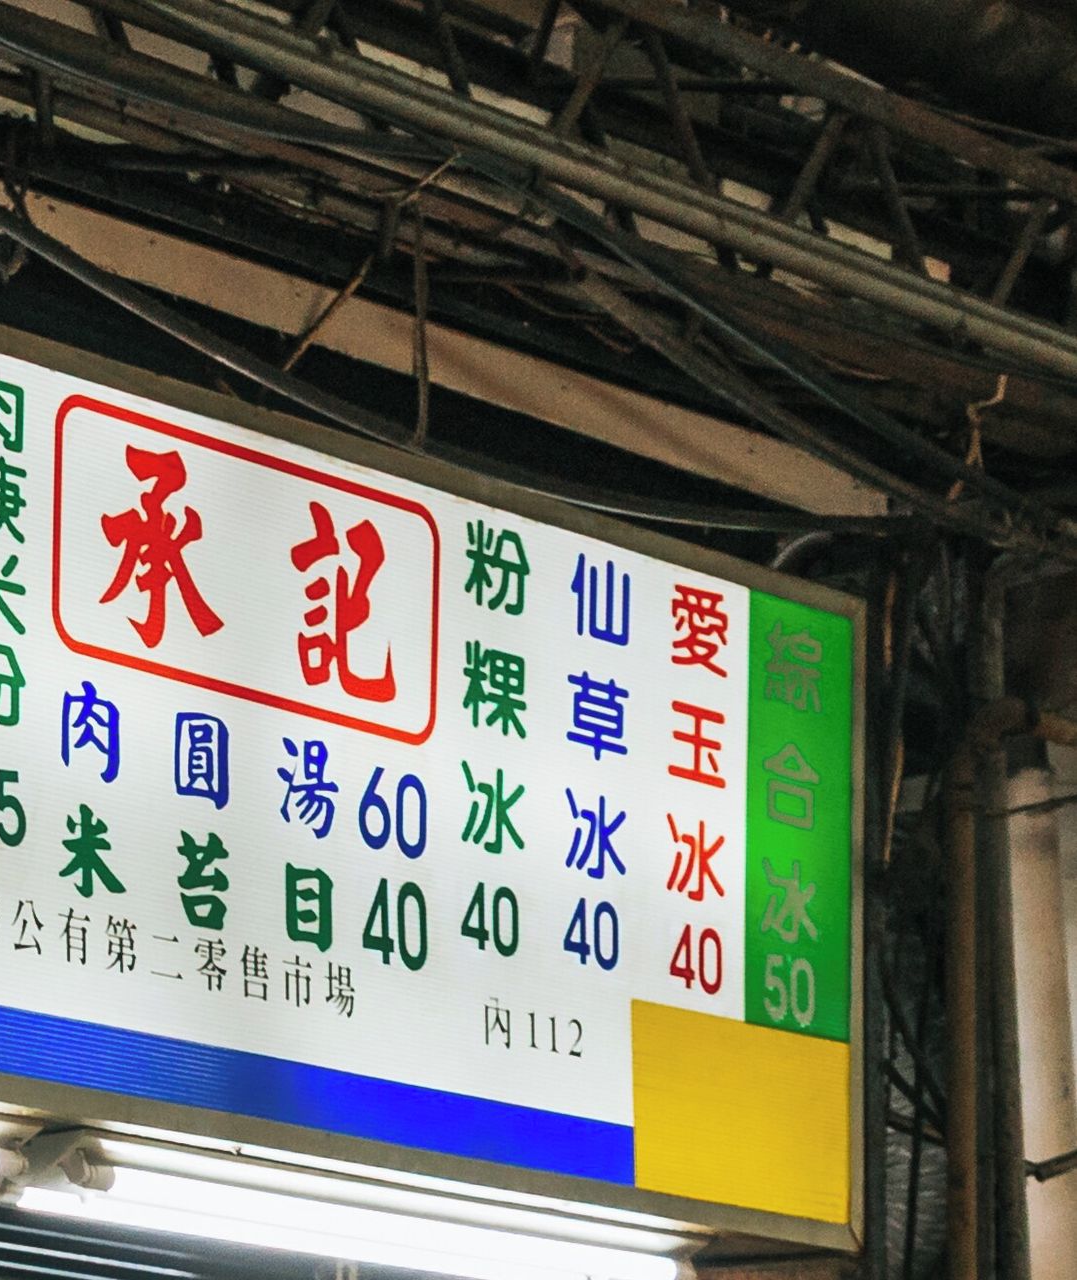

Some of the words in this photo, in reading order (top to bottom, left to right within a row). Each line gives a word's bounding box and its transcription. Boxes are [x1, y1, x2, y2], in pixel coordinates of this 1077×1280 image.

[100, 444, 397, 703] 承記
[461, 519, 530, 855] 粉粿冰
[566, 553, 630, 879] 仙草冰
[667, 583, 727, 901] 愛玉冰
[359, 767, 427, 859] 60
[761, 620, 821, 943] 綜合冰
[59, 803, 333, 952] 米苔目
[362, 878, 428, 971] 40
[461, 882, 519, 957] 40
[563, 898, 619, 970] 40
[670, 924, 722, 995] 40
[763, 954, 815, 1028] 50
